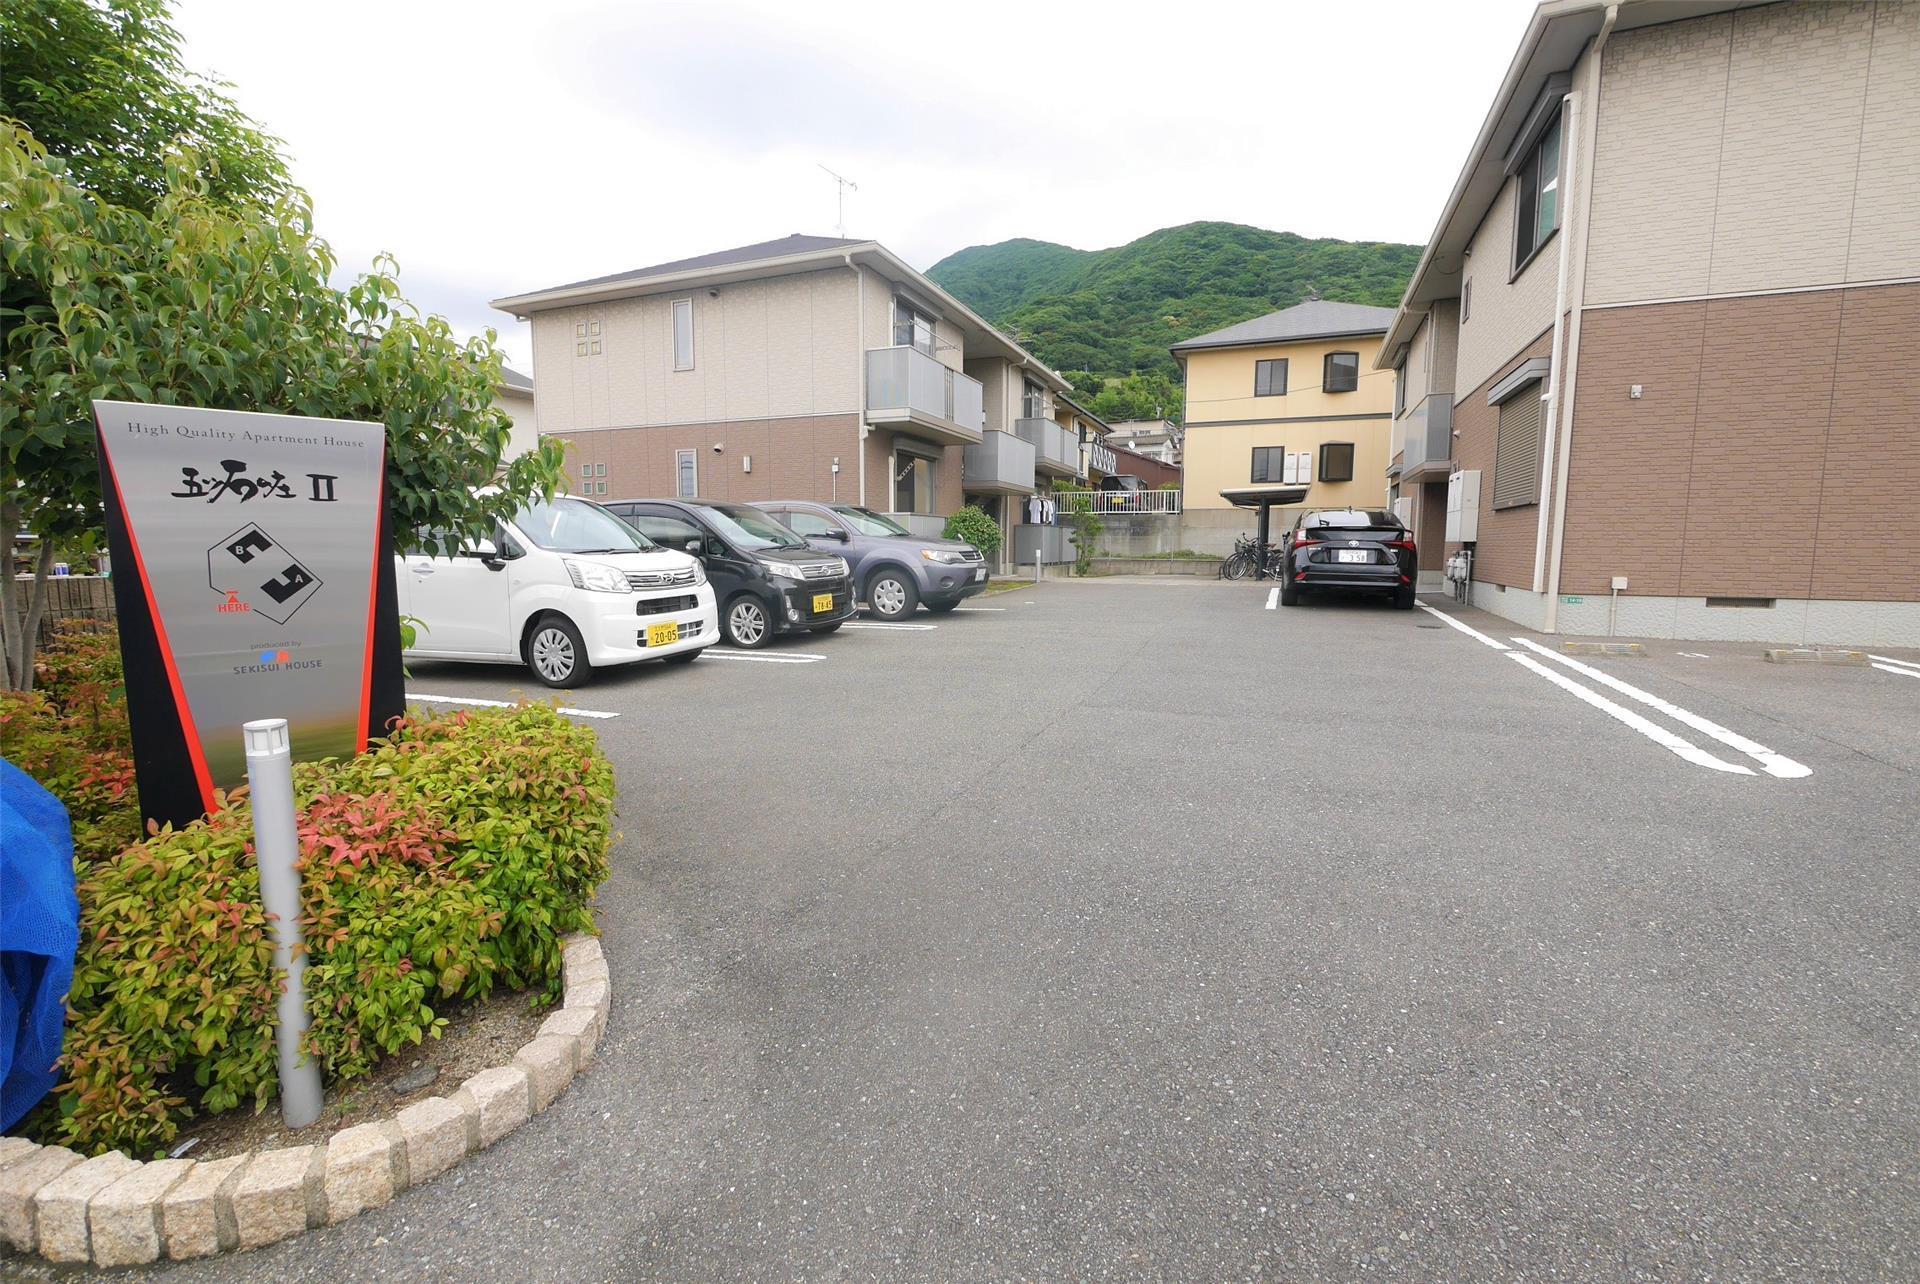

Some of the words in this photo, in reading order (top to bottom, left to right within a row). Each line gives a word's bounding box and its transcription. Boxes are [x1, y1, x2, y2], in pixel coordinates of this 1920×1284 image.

[127, 421, 169, 437] High
[175, 425, 236, 443] Quality
[241, 430, 318, 446] Apartment
[323, 435, 365, 448] House
[235, 546, 244, 555] B
[294, 574, 304, 584] A
[217, 603, 251, 613] HERE
[655, 629, 677, 644] 20-05
[250, 641, 288, 651] produced
[290, 639, 303, 649] by
[232, 663, 280, 676] SEKISUI
[285, 659, 323, 671] HOUSE
